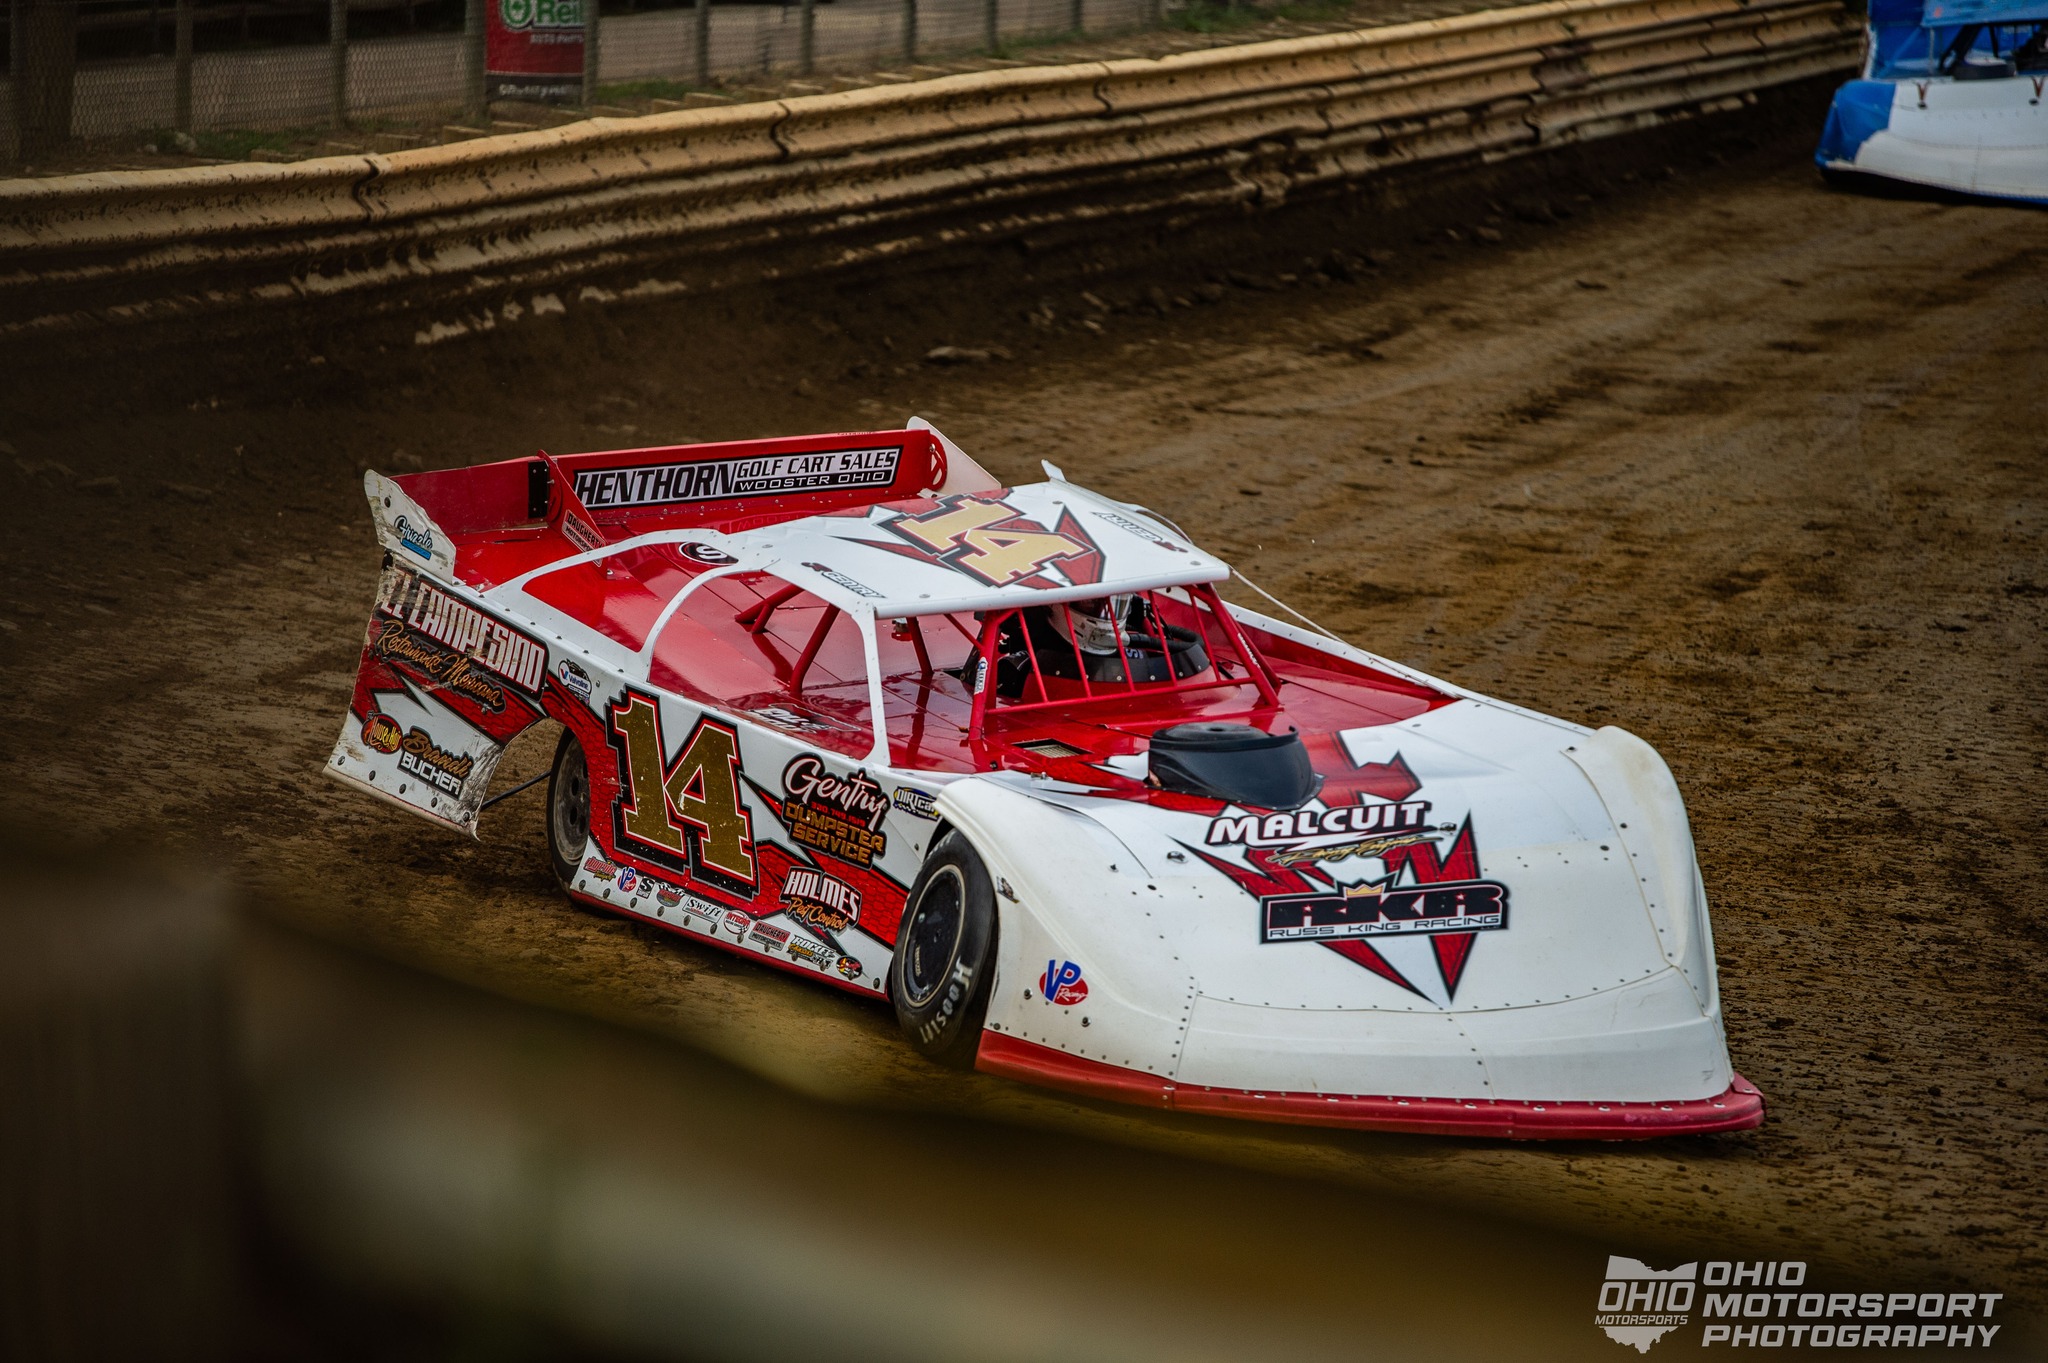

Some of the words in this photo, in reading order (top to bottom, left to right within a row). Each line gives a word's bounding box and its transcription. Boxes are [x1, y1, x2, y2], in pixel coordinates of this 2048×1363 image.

[577, 462, 738, 506] HENTHORN
[736, 460, 784, 480] GOLF
[787, 455, 834, 475] CART
[838, 450, 897, 471] SALES
[739, 476, 830, 491] WOOSTER
[838, 471, 885, 484] OHIO
[894, 497, 1091, 587] 14
[400, 750, 462, 796] BUCHER
[402, 729, 472, 778] Brandi
[613, 696, 754, 881] 14
[784, 757, 887, 833] Gentry
[785, 801, 884, 853] DUMPSTER
[792, 822, 872, 865] SERVICE
[1208, 801, 1427, 848] MALCUIT
[619, 867, 636, 890] VP
[783, 870, 860, 921] HOLMES
[686, 899, 722, 917] Swift
[787, 896, 816, 918] Pest
[808, 905, 849, 930] Control
[1269, 926, 1335, 938] RUSS
[1348, 921, 1401, 933] KING
[1414, 914, 1500, 930] RACING
[1044, 958, 1082, 1002] VP
